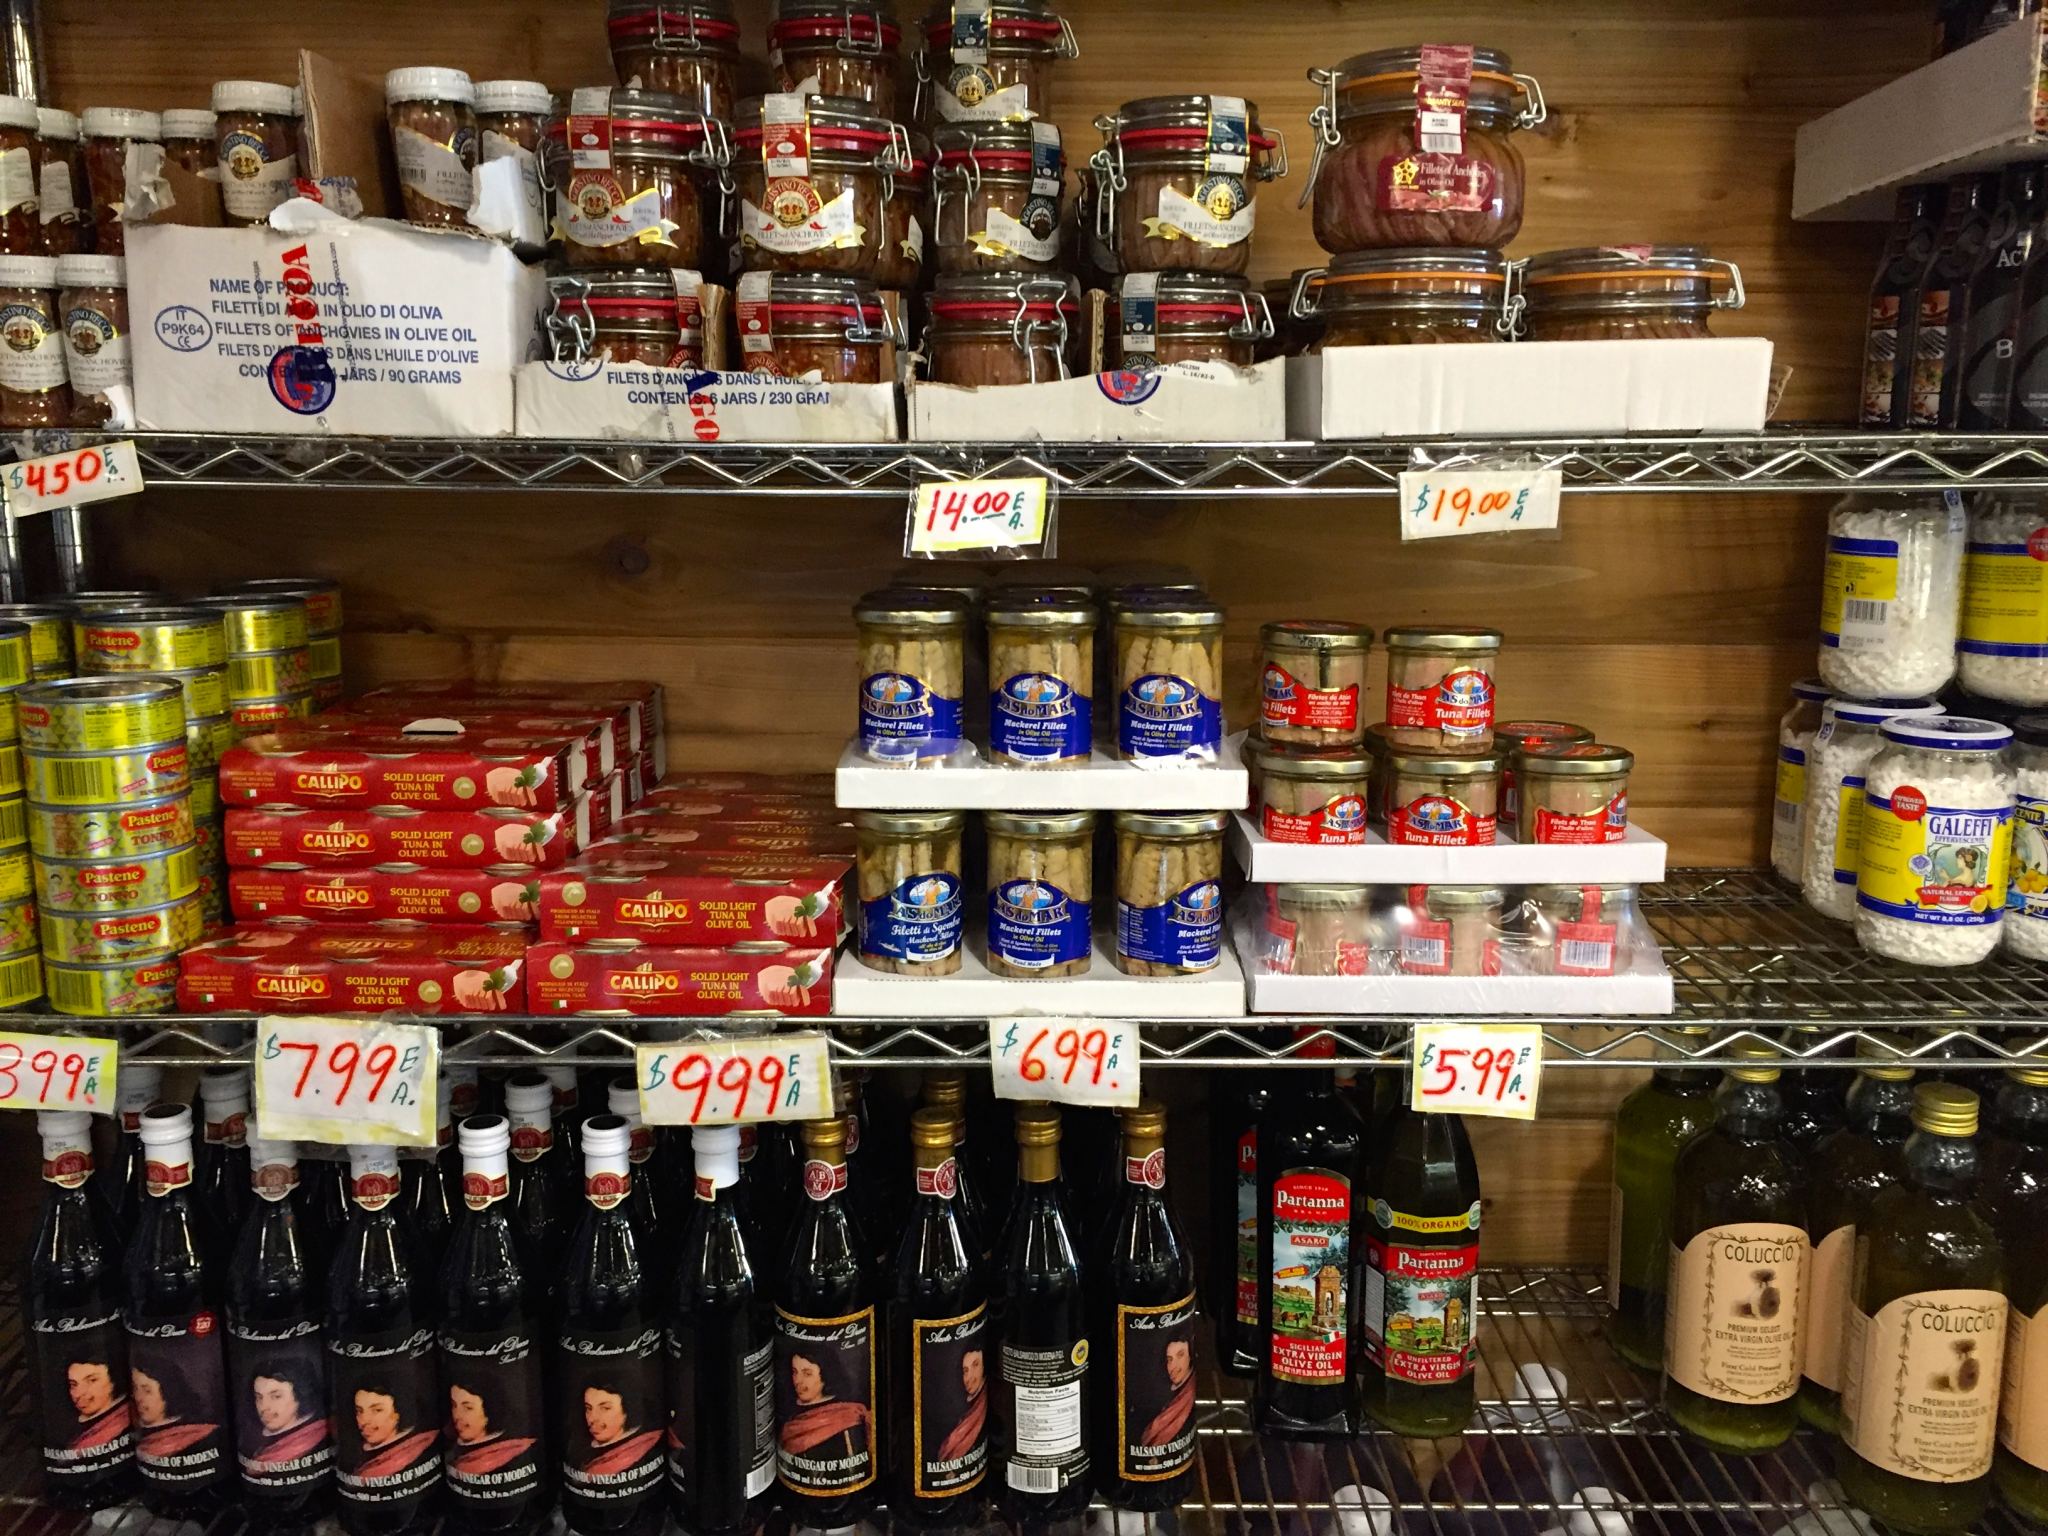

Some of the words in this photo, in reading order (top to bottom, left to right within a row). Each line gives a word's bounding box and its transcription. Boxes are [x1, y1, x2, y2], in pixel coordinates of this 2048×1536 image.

[210, 279, 257, 294] NAME
[176, 309, 187, 322] IT
[266, 301, 280, 316] DI
[324, 303, 338, 318] IN
[342, 304, 376, 319] OLIO
[380, 304, 396, 319] DI
[399, 305, 443, 321] OLIVA
[161, 321, 205, 337] P9K64
[215, 321, 271, 337] FILLETS
[275, 323, 294, 338] OF
[298, 323, 381, 341] ANCHOVIES
[384, 326, 400, 341] IN
[404, 327, 448, 343] OLIVE
[451, 328, 477, 343] OIL
[218, 342, 260, 358] FILETS
[337, 345, 372, 363] DANS
[375, 347, 424, 364] L'HUILE
[427, 348, 479, 365] D'OLIVE
[388, 368, 405, 384] 90
[408, 368, 461, 385] GRAMS
[608, 372, 649, 385] FILETS
[726, 373, 760, 386] DANS
[710, 392, 718, 405] 6
[720, 391, 757, 405] JARS
[760, 391, 765, 405] /
[769, 391, 792, 405] 230
[88, 634, 135, 647] Pastene
[1270, 702, 1297, 715] Fillets
[1435, 708, 1463, 719] Tuna
[1466, 709, 1491, 719] Fillets
[240, 710, 285, 723] Pastene
[865, 718, 897, 730] Mackerel
[898, 721, 924, 731] Fillets
[1004, 719, 1040, 730] Mackerel
[1042, 721, 1068, 731] Fillets
[1131, 720, 1166, 731] Mackerel
[1168, 723, 1193, 732] Fillets
[296, 772, 362, 791] CALLIPO
[383, 773, 411, 783] SOLID
[414, 773, 445, 783] LIGHT
[394, 783, 419, 792] TUNA
[423, 783, 433, 792] IN
[390, 791, 419, 801] OLIVE
[422, 791, 441, 801] OIL
[1896, 801, 1920, 812] TASTE
[128, 809, 176, 828] Pastene
[1929, 816, 1993, 837] GALEFFI
[131, 830, 175, 846] TONNO
[303, 831, 369, 848] CALLIPO
[1320, 833, 1345, 843] Tuna
[1405, 831, 1429, 843] Tuna
[1432, 834, 1467, 846] Fillets
[85, 869, 140, 884] Pastene
[90, 890, 139, 903] TONNO
[305, 888, 369, 905] CALLIPO
[620, 902, 688, 920] CALLIPO
[699, 902, 726, 912] SOLID
[729, 902, 757, 912] LIGHT
[710, 911, 734, 920] TUNA
[737, 911, 747, 920] IN
[100, 919, 156, 935] Pastene
[705, 920, 733, 930] OLIVE
[735, 920, 752, 930] OIL
[891, 924, 922, 936] Filetti
[1000, 923, 1034, 935] Mackerel
[1036, 927, 1061, 936] Fillets
[256, 977, 325, 995] CALLIPO
[610, 974, 679, 991] CALLIPO
[1277, 1189, 1345, 1208] Partanna
[1294, 1236, 1327, 1246] ASARO
[1398, 1251, 1464, 1270] Partanna
[1724, 1243, 1794, 1264] COLUCCIO
[1922, 1311, 1996, 1334] COLUCCIO
[1273, 1345, 1306, 1360] EXTRA
[1308, 1351, 1342, 1361] VIRGIN
[1289, 1342, 1326, 1352] SICILIAN
[1281, 1357, 1313, 1369] OLIVE
[1315, 1361, 1333, 1370] OIL
[1393, 1358, 1428, 1372] EXTRA
[1430, 1360, 1461, 1371] VIRGIN
[1407, 1354, 1452, 1363] UNFILTERED
[1407, 1369, 1434, 1379] OLIVE
[1435, 1371, 1450, 1379] OIL
[1130, 1444, 1168, 1458] BALSAMIC
[827, 1459, 838, 1473] OF
[839, 1450, 869, 1471] MODENA
[927, 1456, 964, 1474] BALSAMIC
[403, 1470, 414, 1484] OF
[492, 1473, 503, 1486] OF
[504, 1463, 537, 1484] MODENA
[629, 1467, 640, 1482] OF
